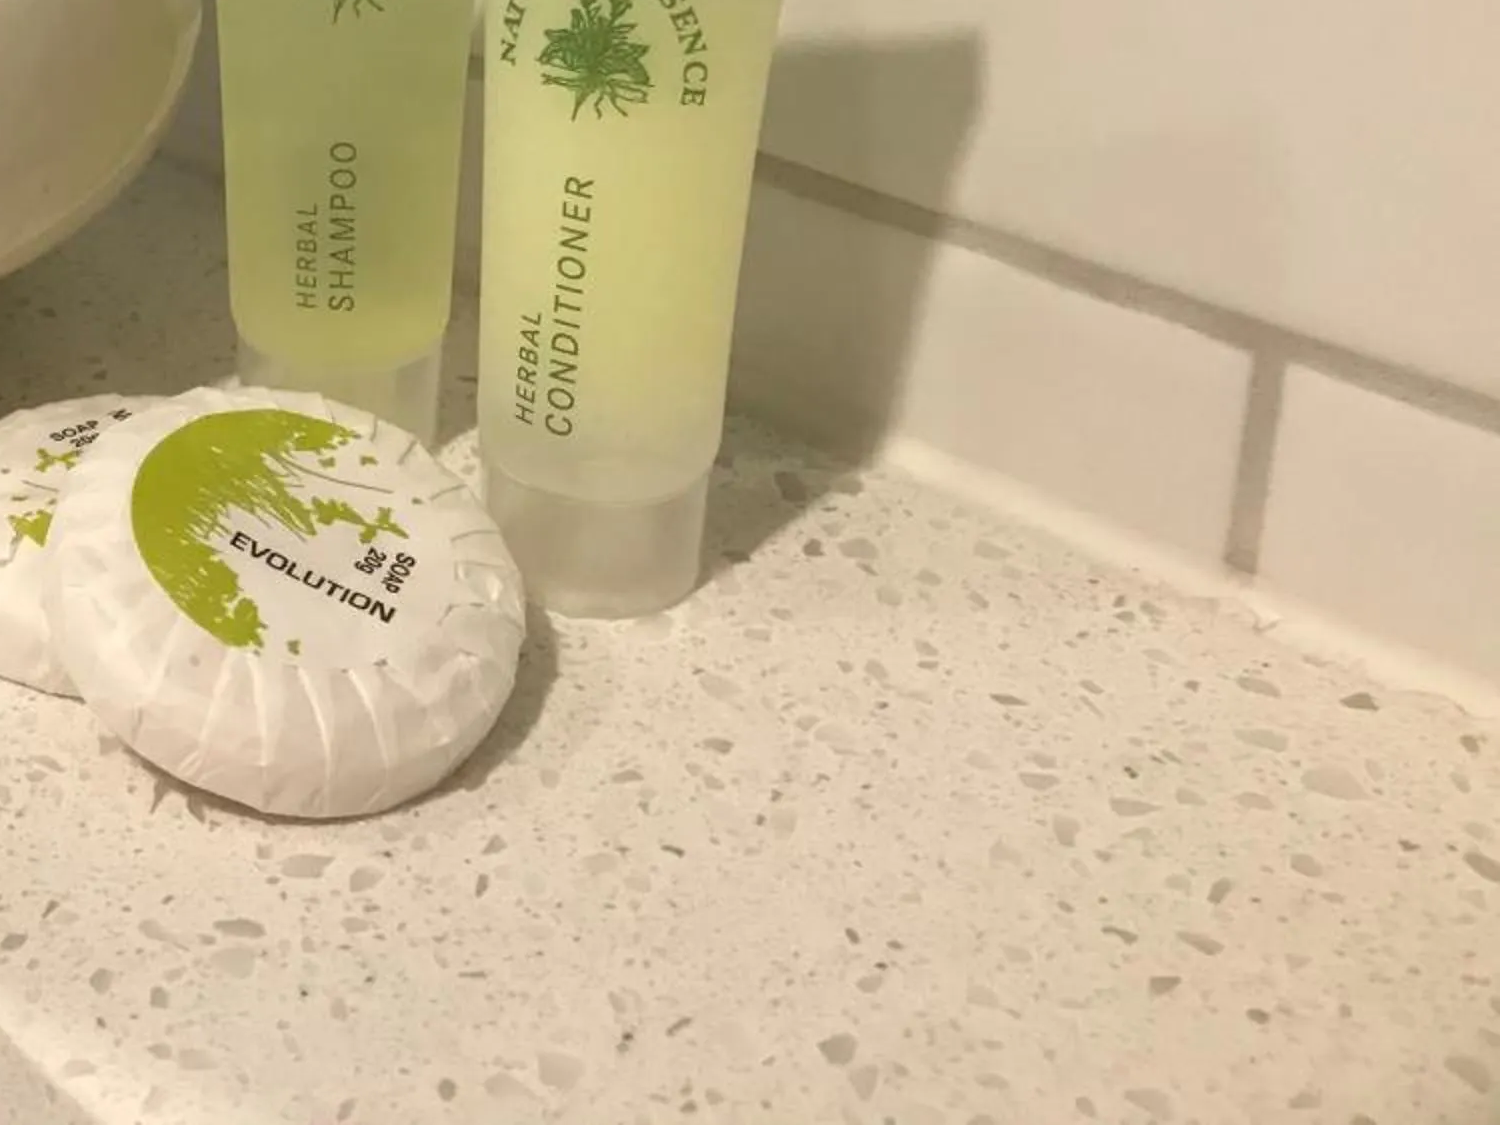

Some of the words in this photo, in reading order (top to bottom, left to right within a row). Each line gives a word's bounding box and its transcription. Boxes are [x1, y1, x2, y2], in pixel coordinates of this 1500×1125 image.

[295, 203, 318, 310] HERBAL
[328, 141, 357, 312] SHAMPOO
[544, 175, 595, 437] CONDITIONER
[515, 311, 542, 426] HERBAL
[229, 531, 397, 624] EVOLUTION
[354, 547, 387, 575] 20g
[381, 552, 416, 594] SOAP
